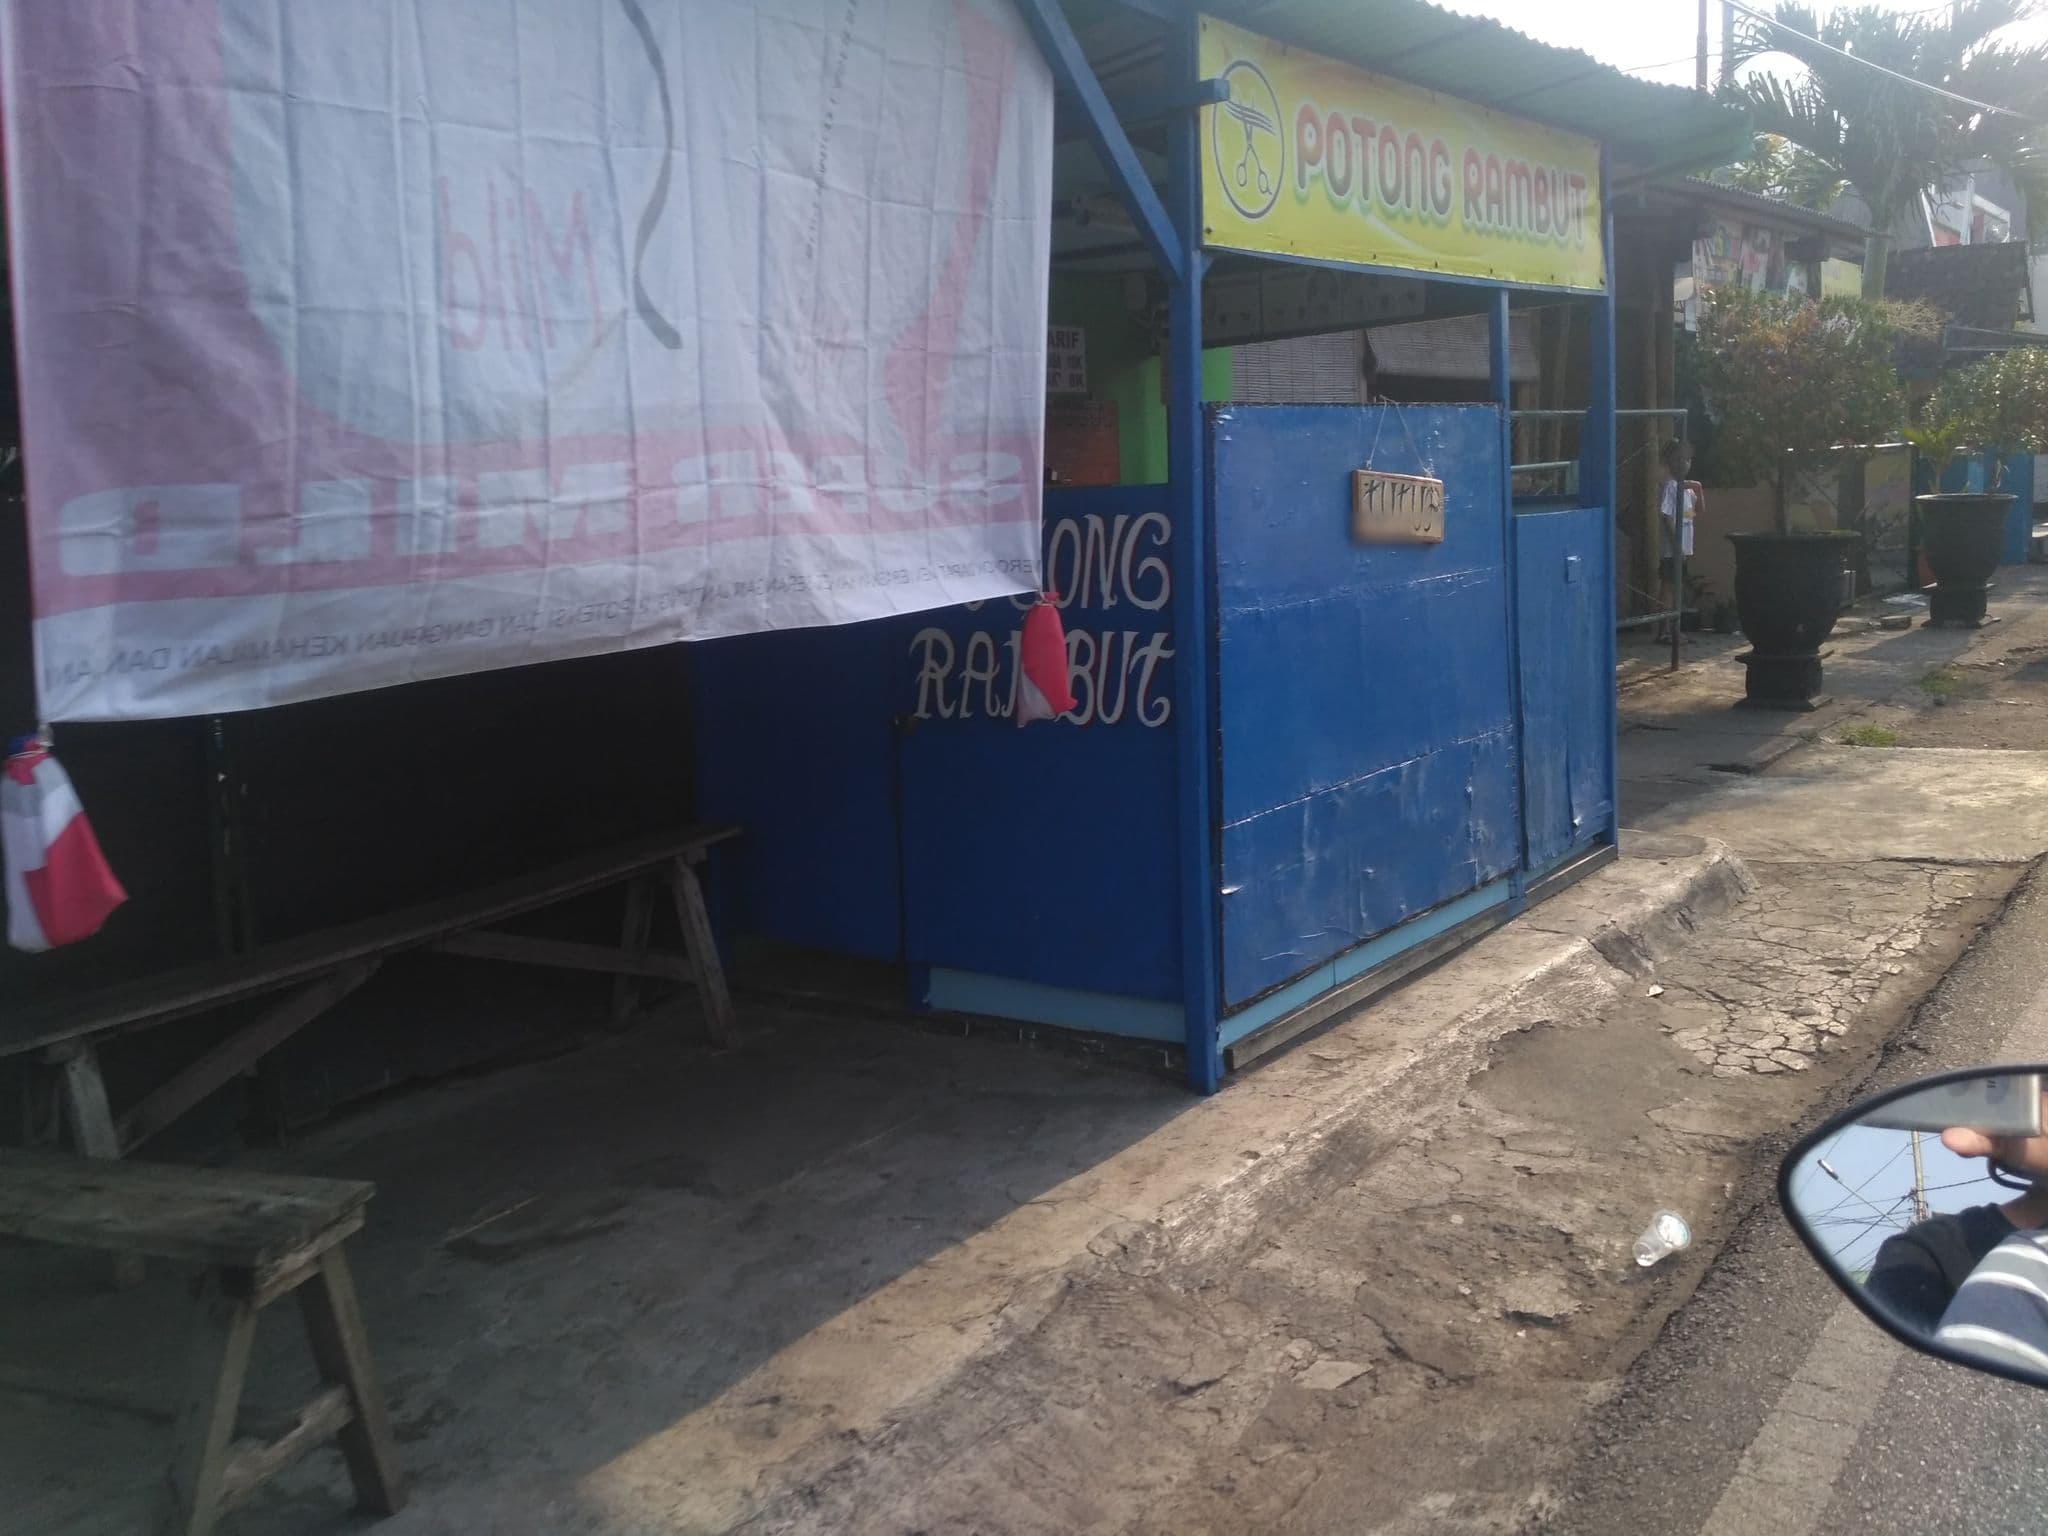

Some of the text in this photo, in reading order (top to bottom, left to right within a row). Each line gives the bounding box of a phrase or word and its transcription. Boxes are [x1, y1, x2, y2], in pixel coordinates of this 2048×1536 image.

[1295, 101, 1588, 243] POTONG RAMBUT
[1048, 330, 1080, 349] ARIF
[909, 627, 1176, 728] RABUT
